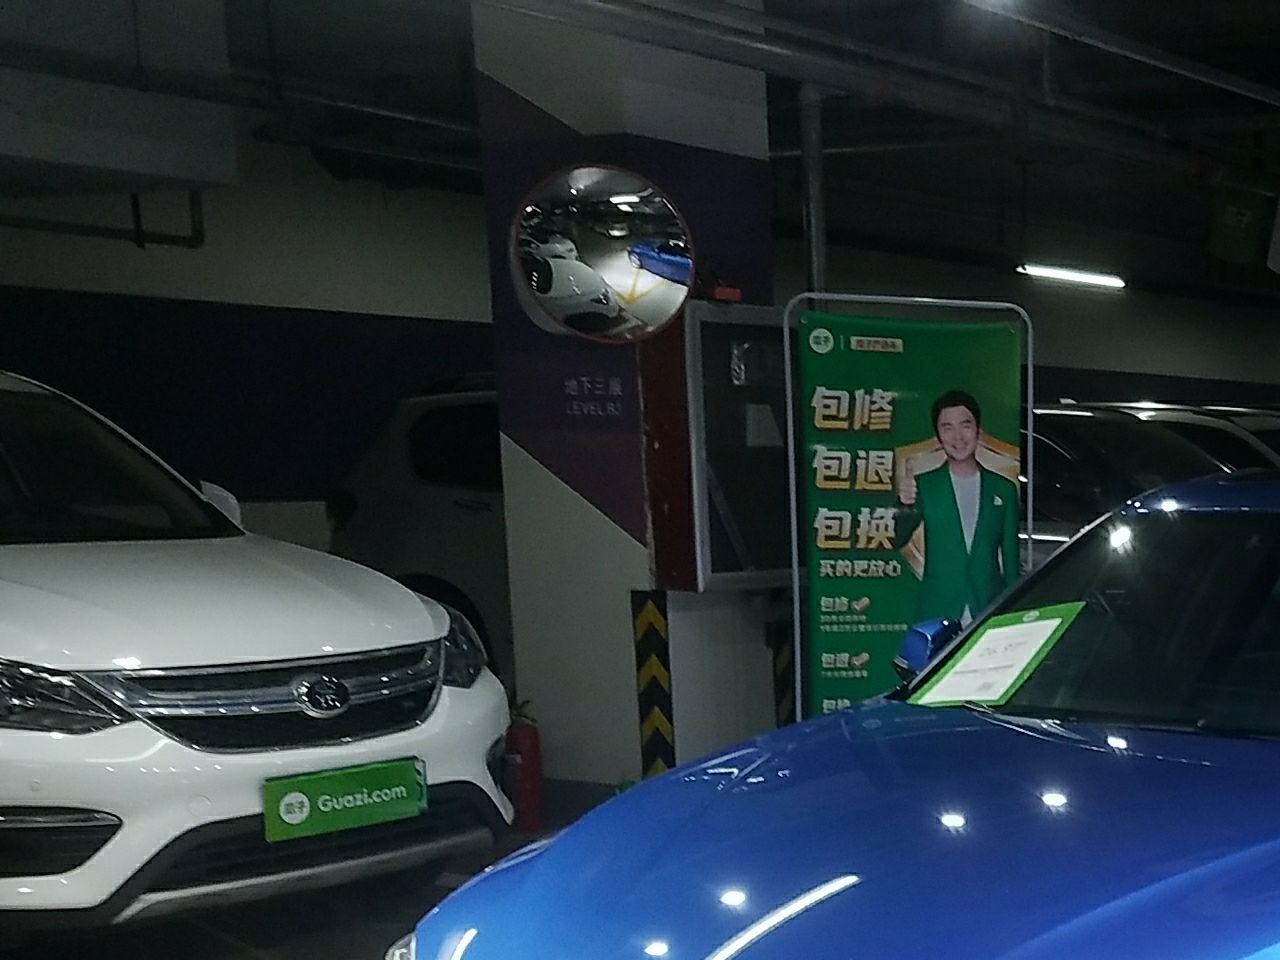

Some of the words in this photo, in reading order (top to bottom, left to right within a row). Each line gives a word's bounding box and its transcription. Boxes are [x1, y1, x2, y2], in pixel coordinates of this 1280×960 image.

[812, 385, 895, 432] 包修
[812, 448, 895, 492] 包退
[813, 506, 896, 550] 包换
[819, 559, 902, 577] 买的更放心
[317, 784, 408, 812] Guazi.com
